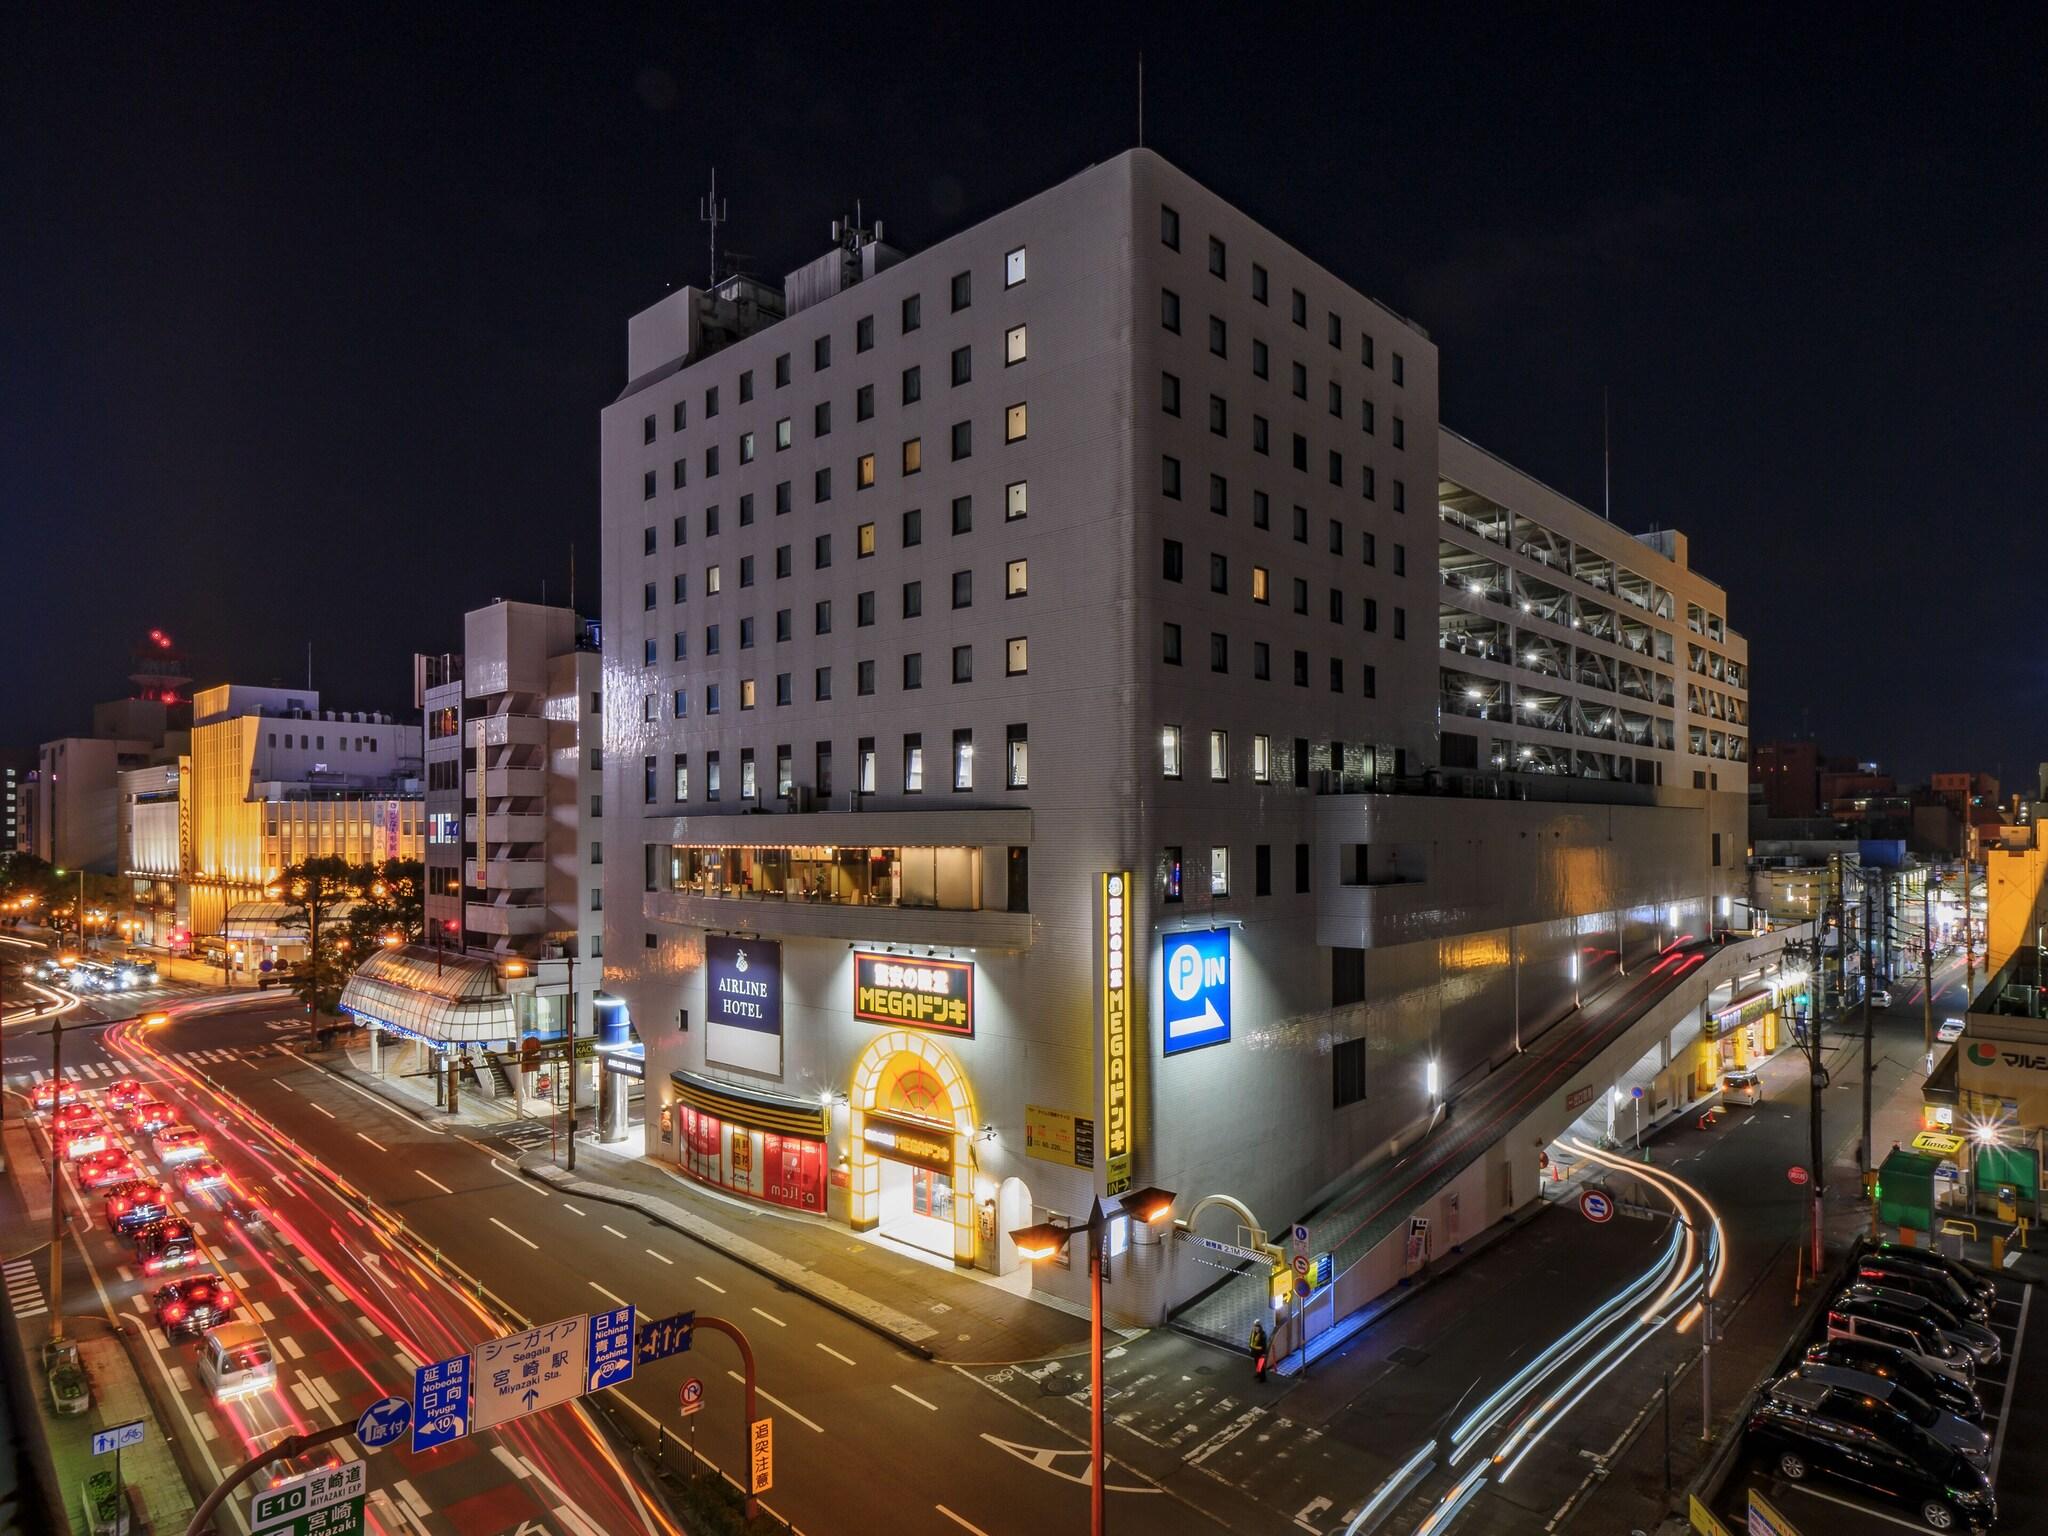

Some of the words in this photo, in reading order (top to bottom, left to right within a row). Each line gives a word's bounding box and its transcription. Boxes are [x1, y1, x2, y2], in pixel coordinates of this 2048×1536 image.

[1204, 956, 1226, 988] IN
[718, 977, 768, 998] AIRLINE
[723, 998, 763, 1019] HOTEL
[860, 986, 966, 1025] MEGAドンキ
[1109, 989, 1125, 1151] MEGAドンキ
[1920, 1135, 1957, 1151] Times
[1108, 1181, 1119, 1196] IN
[596, 1309, 630, 1331] 日南
[486, 1321, 578, 1361] シーガイア
[595, 1324, 629, 1340] Nichinan
[513, 1345, 551, 1363] Seagaia
[595, 1347, 628, 1363] Aoshima
[423, 1359, 463, 1384] 延岡
[493, 1350, 569, 1388] 宮崎駅
[602, 1362, 615, 1374] 220
[422, 1376, 463, 1393] Nobeoka
[499, 1375, 540, 1396] Miyazaki
[544, 1371, 562, 1382] Sta.
[423, 1386, 462, 1410] 日向
[427, 1403, 456, 1418] Hyuga
[372, 1419, 405, 1440] 原付
[437, 1420, 451, 1430] 10
[755, 1423, 769, 1490] 追突注意
[311, 1466, 361, 1497] 宮崎道
[310, 1489, 346, 1508] MIYAZAKI
[348, 1483, 362, 1495] EXP
[307, 1502, 352, 1531] 宮崎
